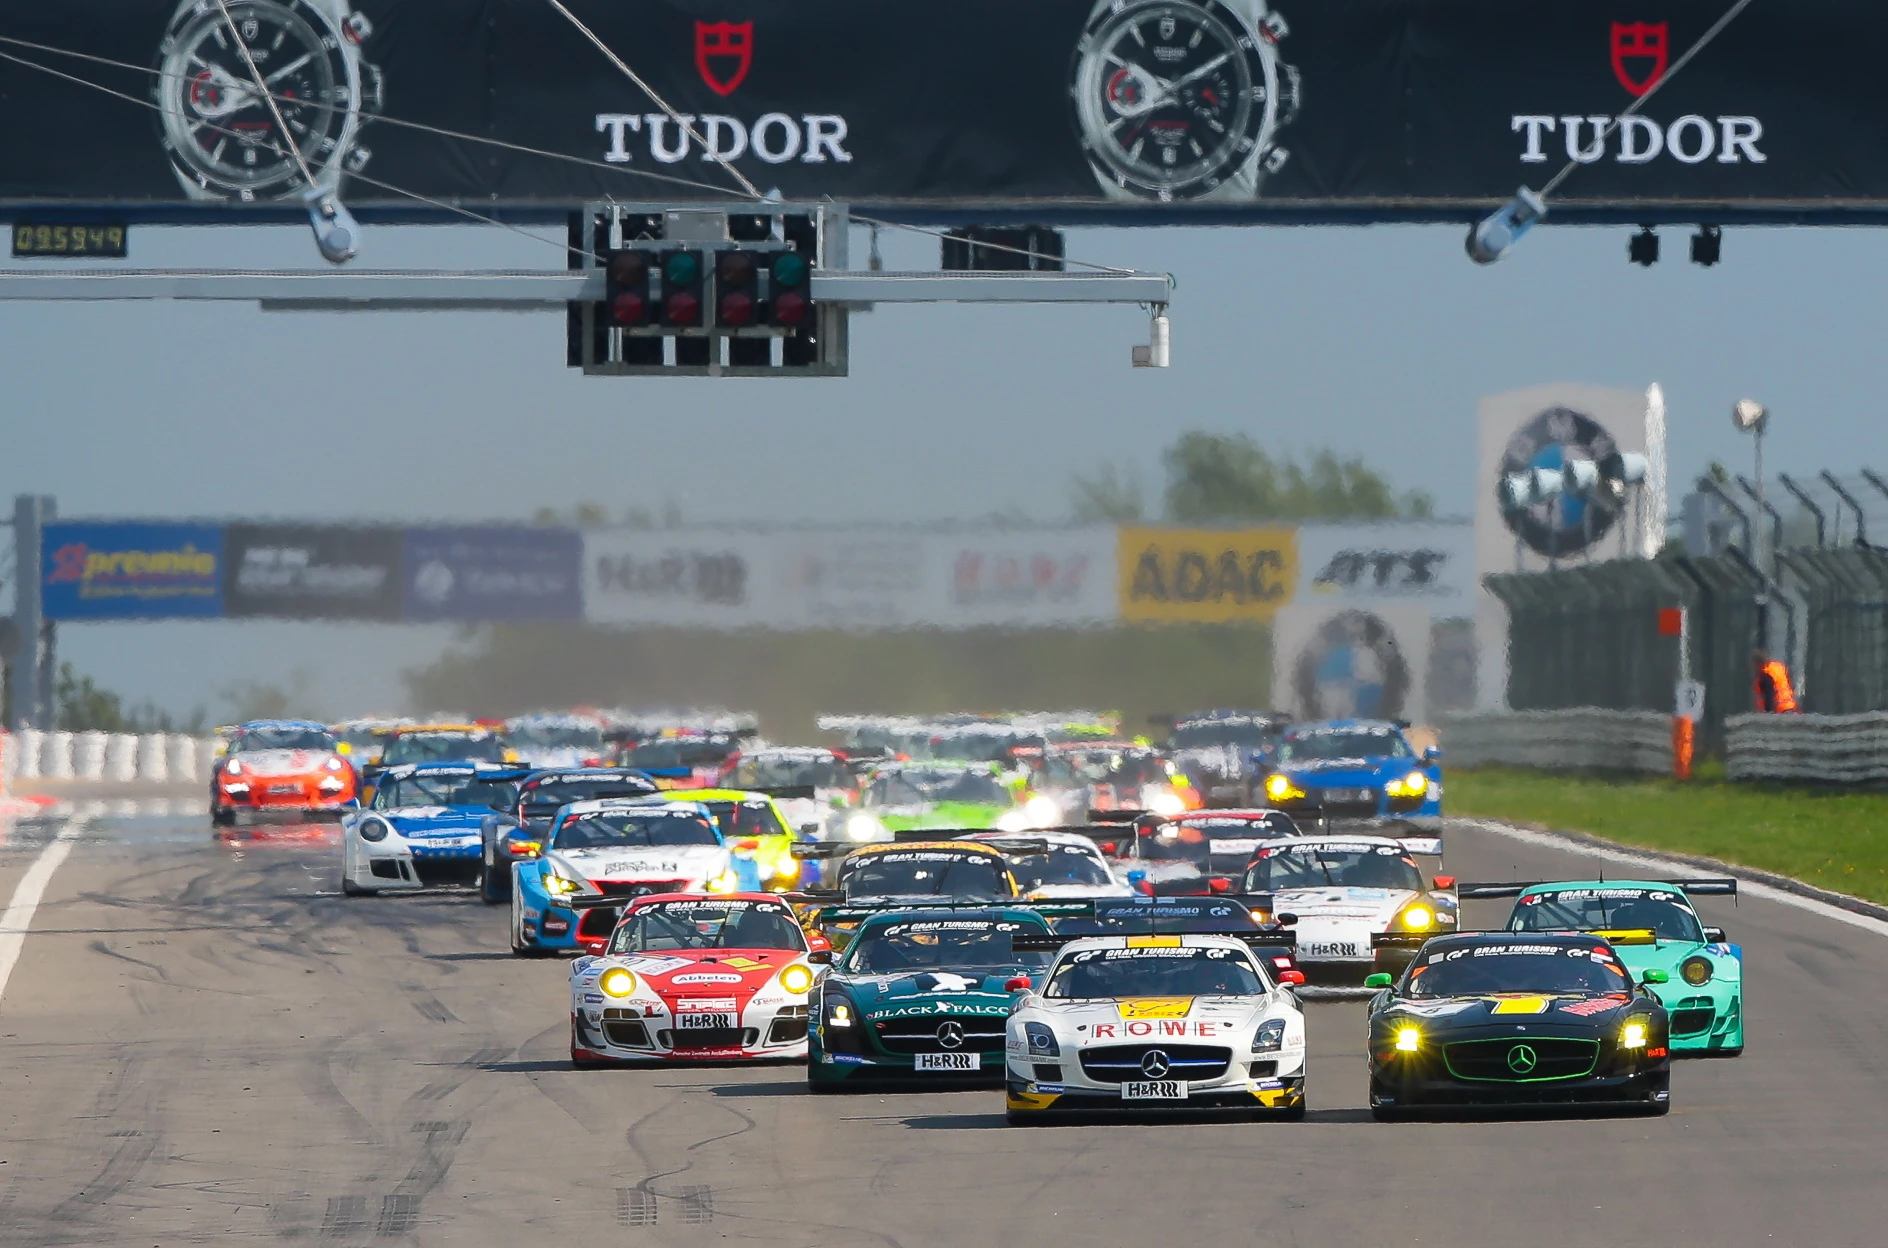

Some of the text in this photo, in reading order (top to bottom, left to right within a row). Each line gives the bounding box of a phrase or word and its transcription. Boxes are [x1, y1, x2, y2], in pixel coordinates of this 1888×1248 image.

[595, 112, 853, 165] TUDOR
[1511, 114, 1767, 164] TUDOR
[1131, 546, 1285, 603] ADAC
[700, 900, 749, 908] TURISMO
[911, 923, 941, 931] GRAN
[1105, 948, 1139, 957] GRAN
[1143, 947, 1197, 956] TURISMO
[1474, 945, 1506, 954] GRAN
[1509, 944, 1559, 953] TURISMO
[874, 1006, 932, 1019] BLACK
[1096, 1021, 1217, 1038] ROWE
